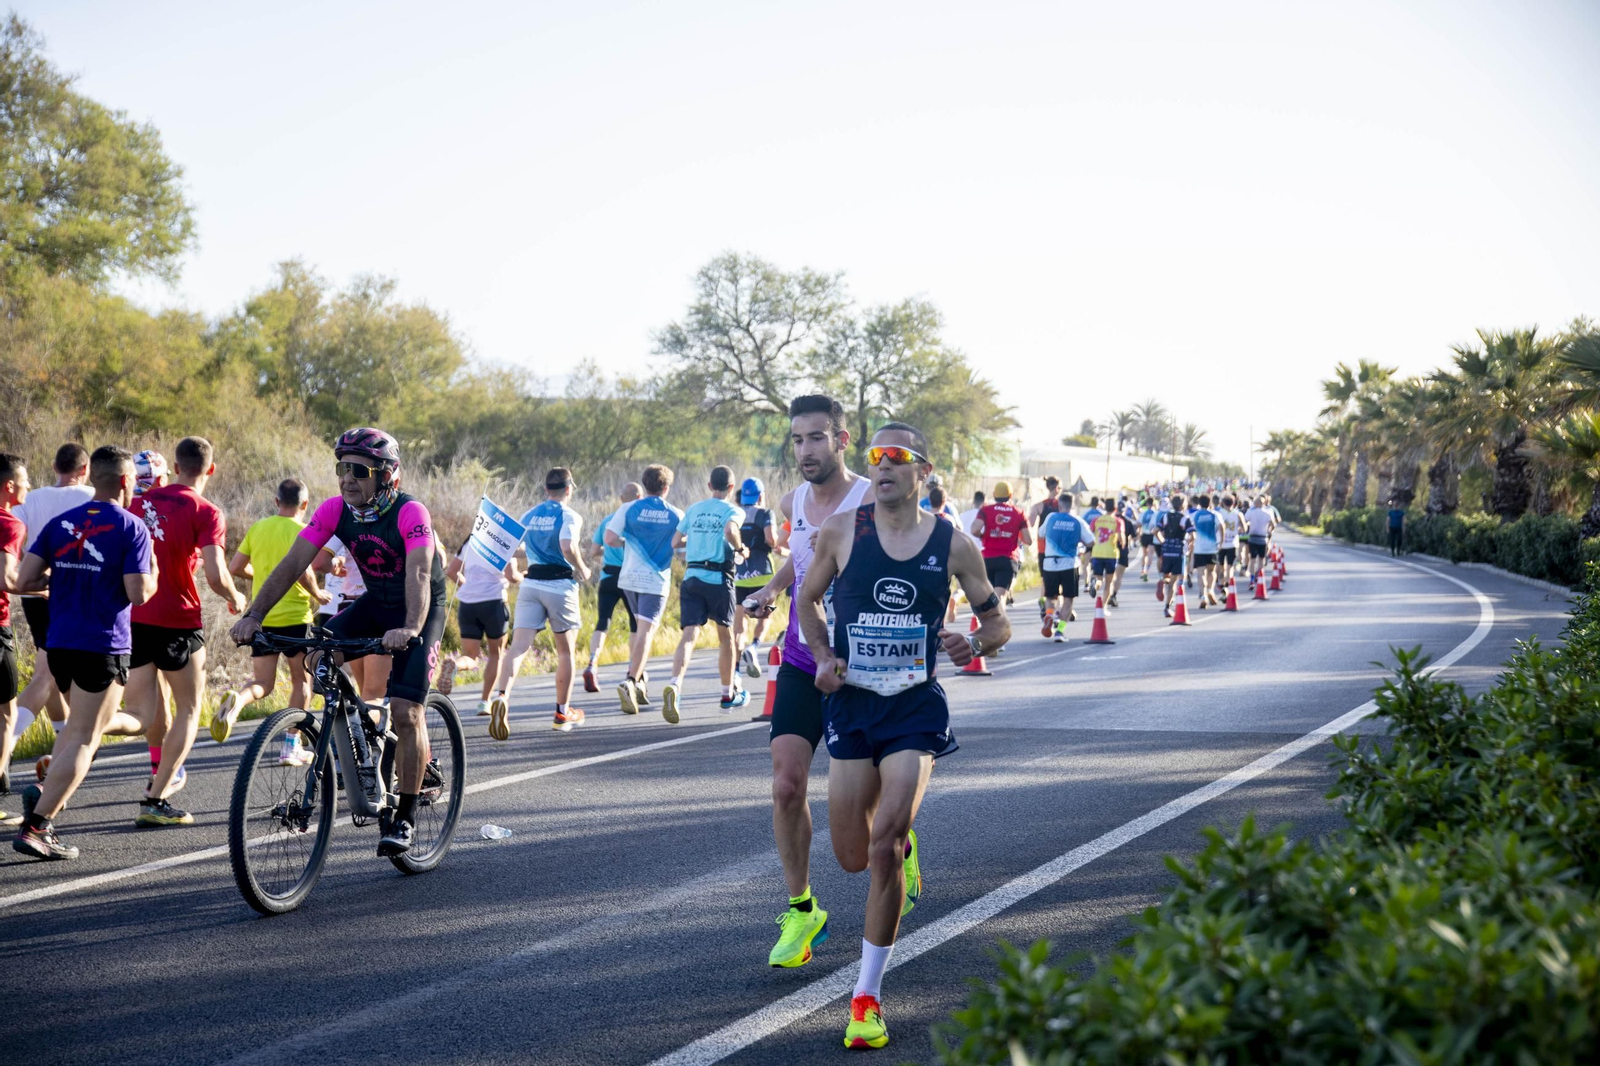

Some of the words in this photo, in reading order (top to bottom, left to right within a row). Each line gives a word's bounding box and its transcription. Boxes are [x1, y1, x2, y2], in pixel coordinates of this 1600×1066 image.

[640, 508, 669, 519] ALMERÍA
[486, 529, 511, 551] MASCULINO
[920, 564, 942, 572] VIATOR
[879, 592, 908, 606] Reina
[858, 612, 922, 628] PROTEINAS
[857, 641, 919, 657] ESTANI
